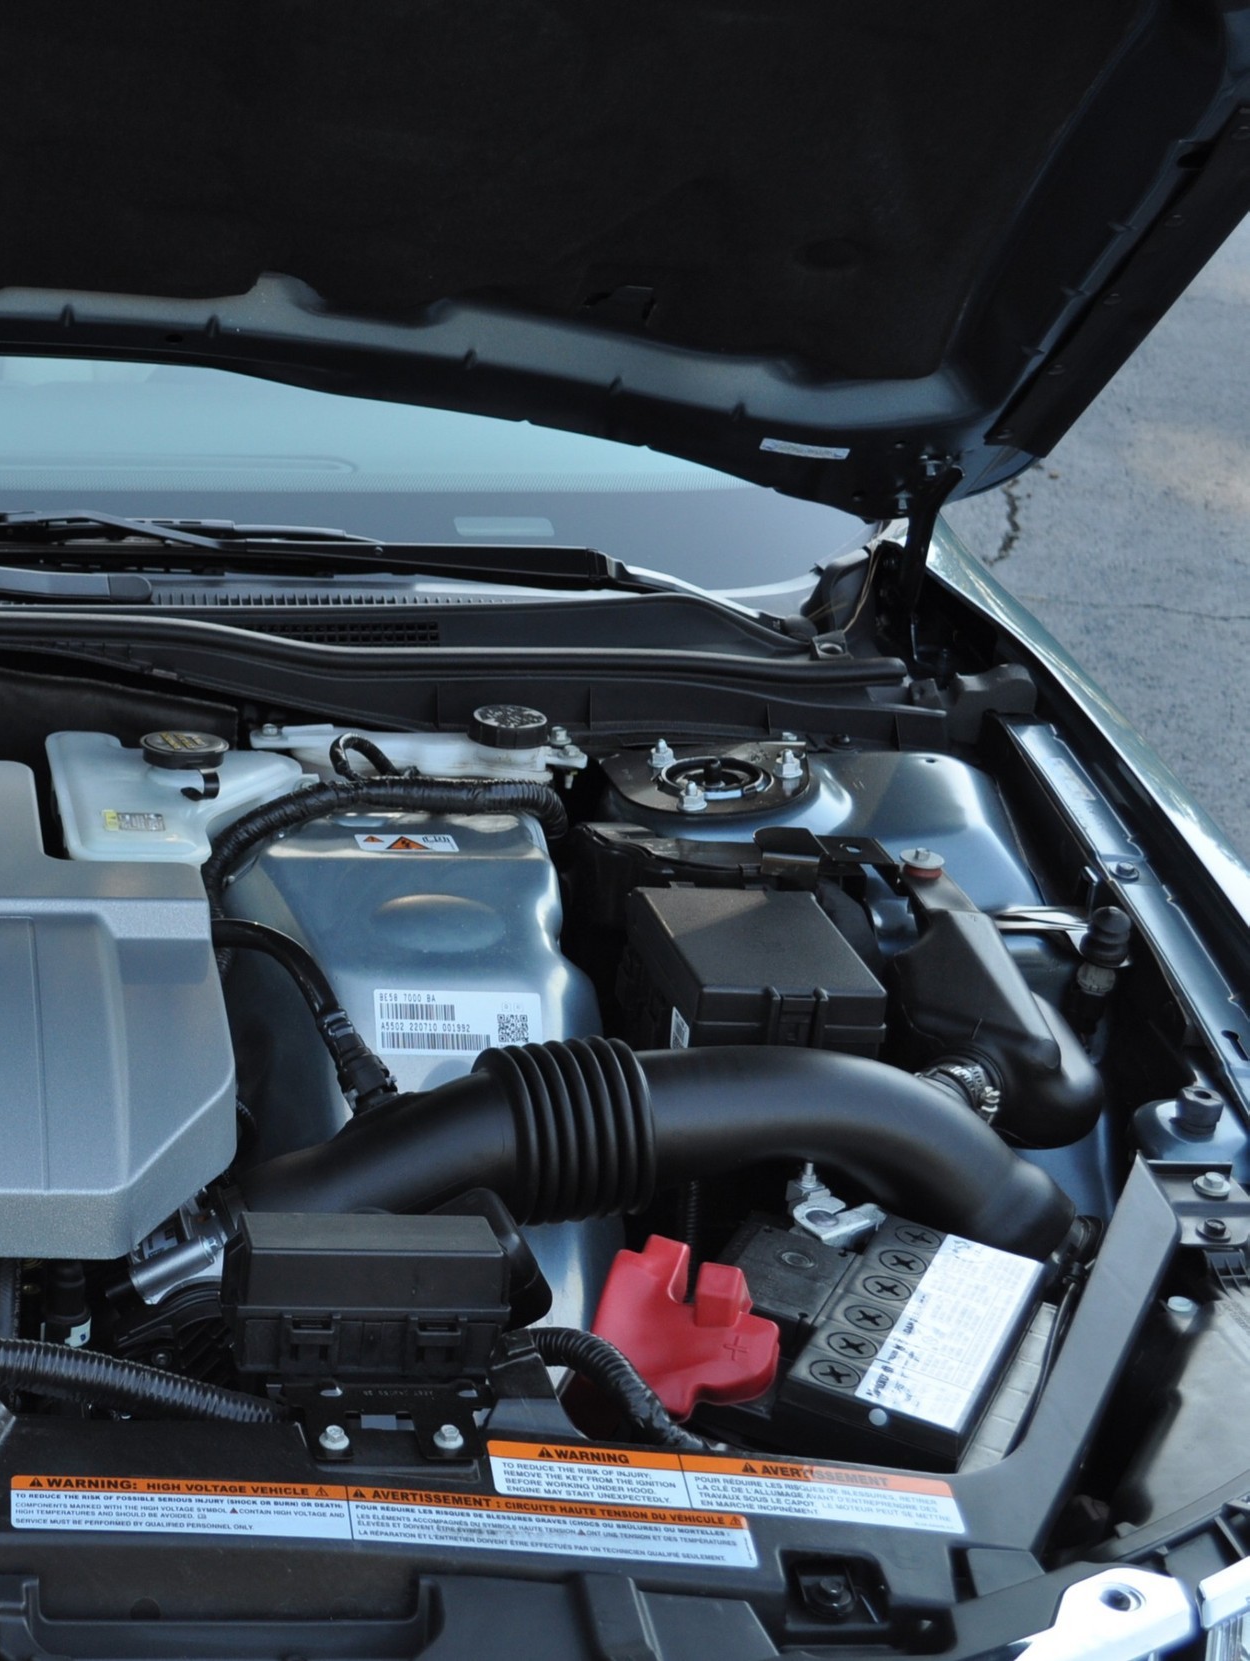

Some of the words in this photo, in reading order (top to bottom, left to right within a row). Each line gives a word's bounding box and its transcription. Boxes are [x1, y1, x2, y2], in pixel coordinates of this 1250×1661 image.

[403, 993, 422, 1003] 7000
[409, 1022, 438, 1032] 220710
[554, 1449, 629, 1463] WARNING
[516, 1463, 554, 1471] REDUCE
[503, 1469, 542, 1478] REMOVE
[635, 1479, 676, 1487] IGNITION
[759, 1464, 888, 1486] AVERTISSEMENT
[47, 1477, 136, 1490] WARNING:
[146, 1482, 180, 1491] HIGH
[185, 1484, 246, 1493] VOLTAGE
[251, 1486, 308, 1495] VEHICLE
[504, 1477, 542, 1486] BEFORE
[544, 1480, 590, 1489] WORKING
[591, 1484, 624, 1492] UNDER
[506, 1485, 540, 1493] ENGINE
[371, 1490, 492, 1507] AVERTISSEMENT
[504, 1500, 556, 1511] CIRCUITS
[558, 1504, 596, 1514] HAUTE
[599, 1507, 648, 1518] TENSION
[649, 1510, 667, 1519] DU
